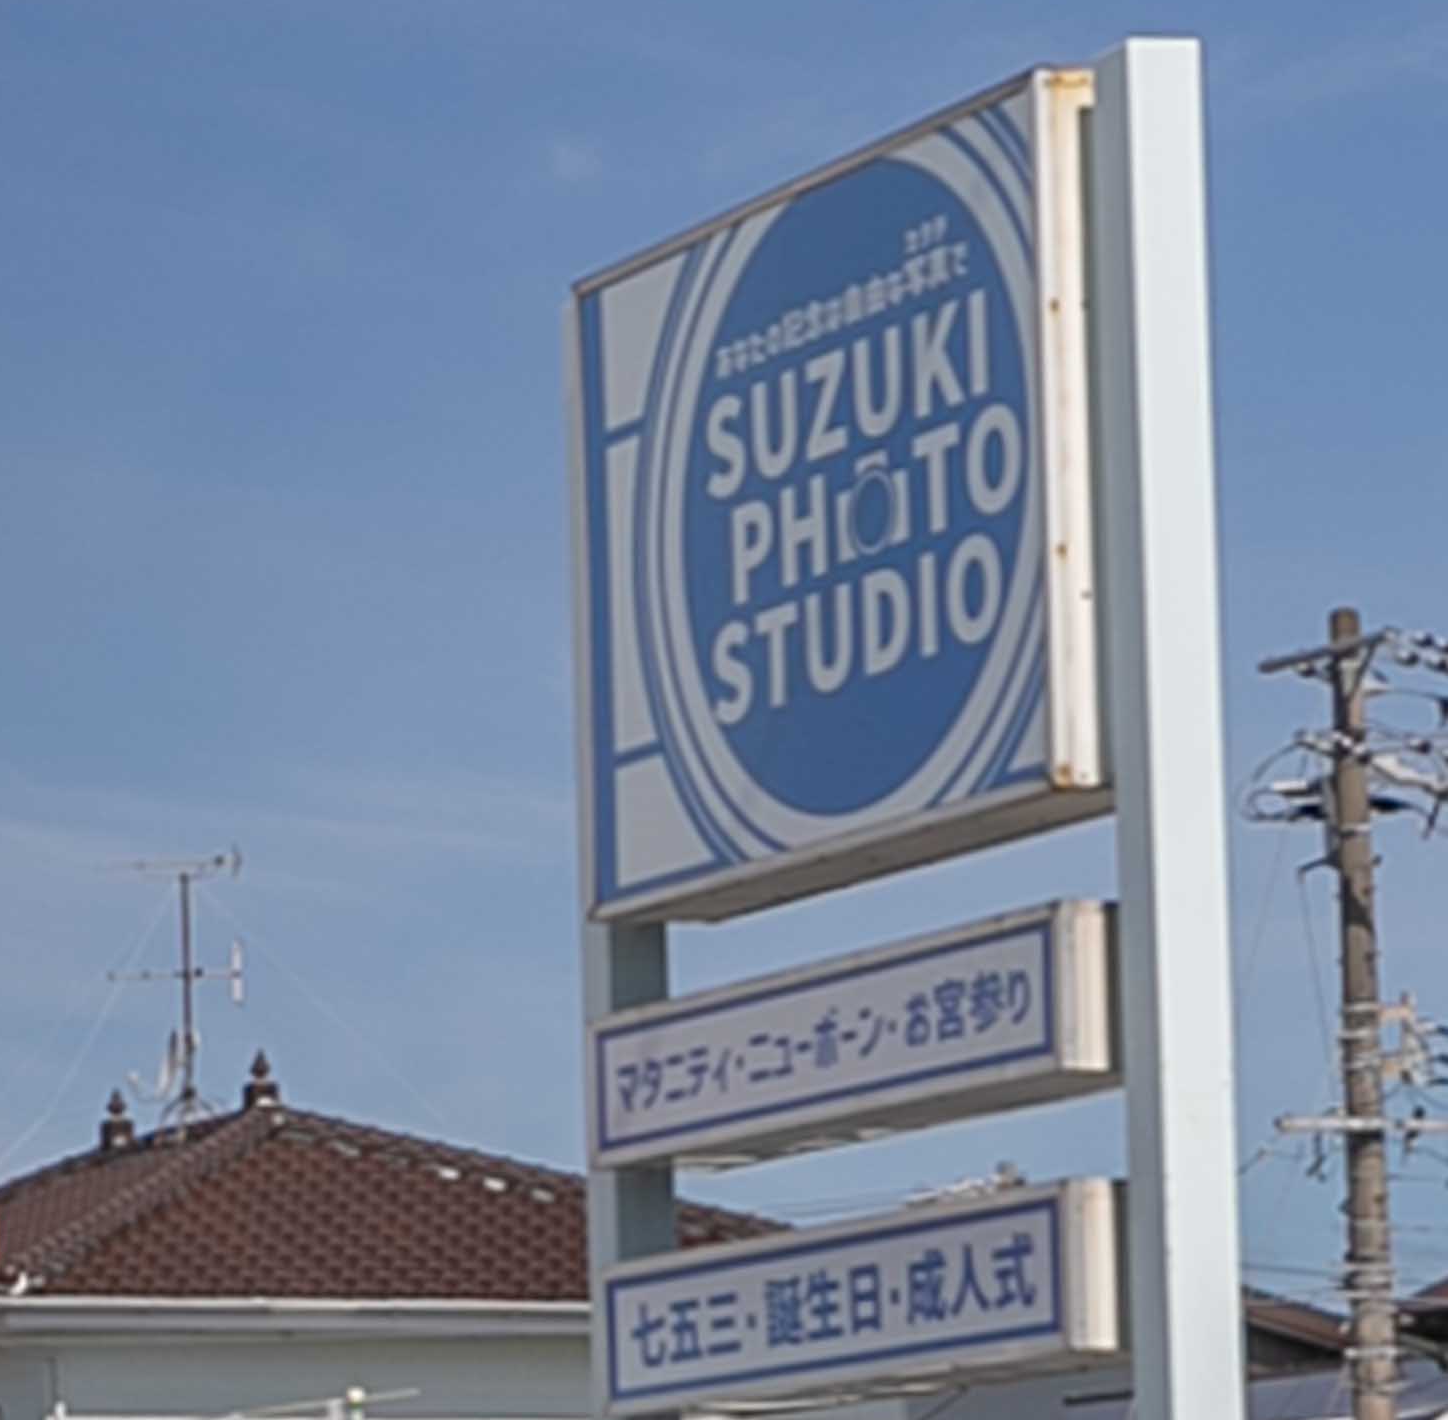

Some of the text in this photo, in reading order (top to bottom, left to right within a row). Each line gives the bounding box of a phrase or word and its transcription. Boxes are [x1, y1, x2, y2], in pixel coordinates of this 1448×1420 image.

[706, 289, 987, 499] SUZUKI
[714, 533, 1002, 725] STUDIO
[631, 1232, 1036, 1368] 七五三・誕生日・成人式
